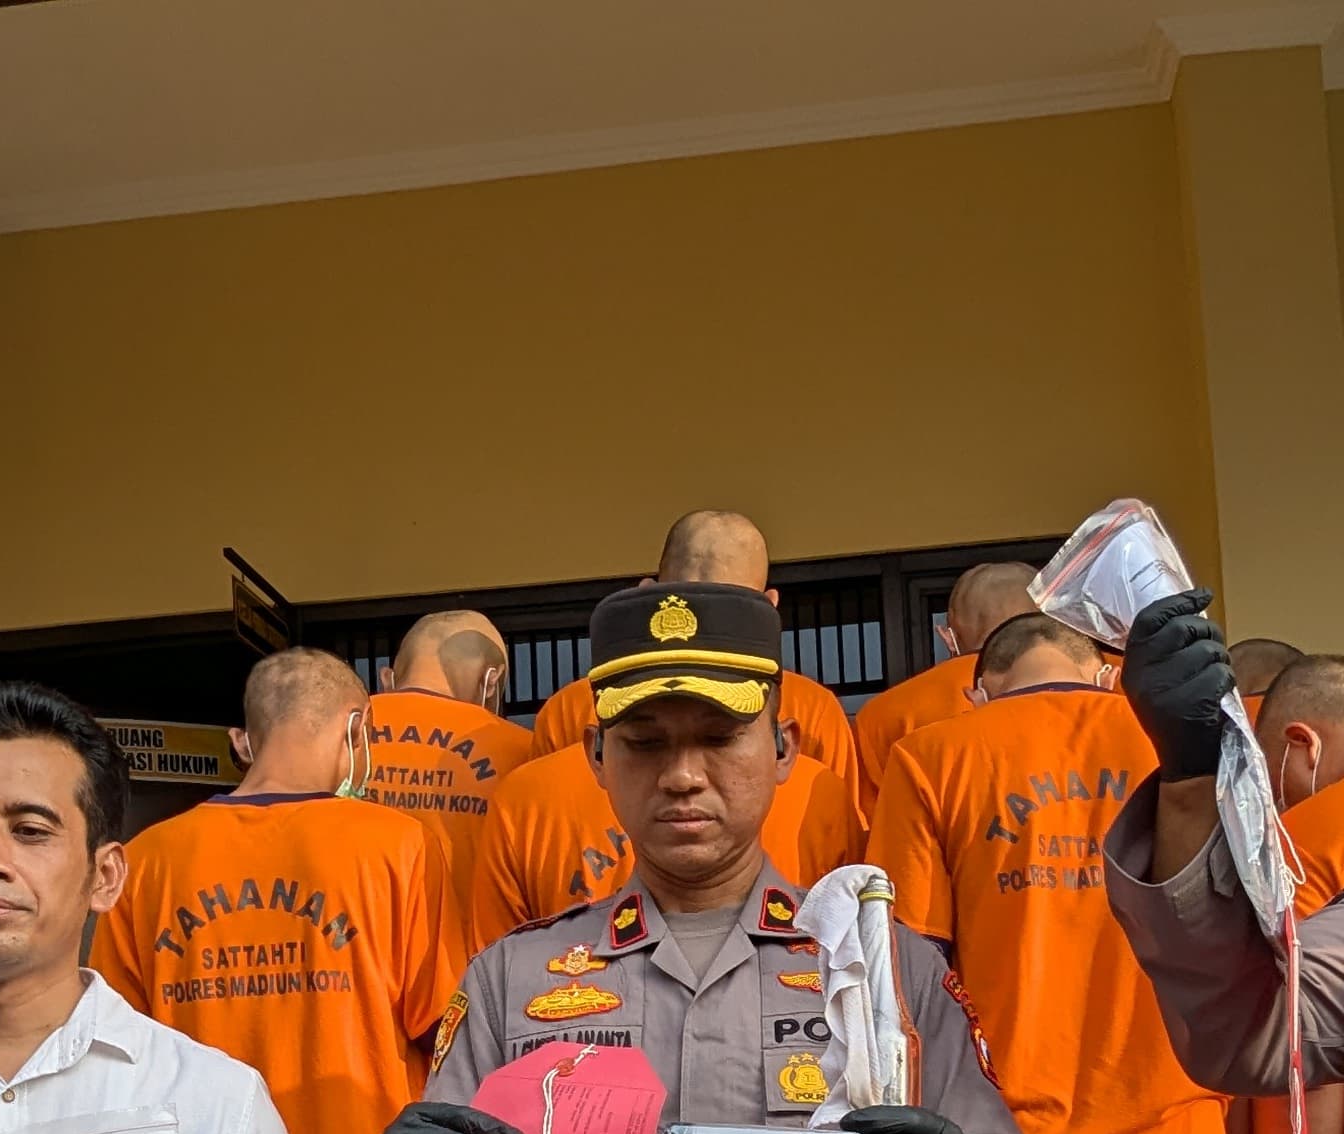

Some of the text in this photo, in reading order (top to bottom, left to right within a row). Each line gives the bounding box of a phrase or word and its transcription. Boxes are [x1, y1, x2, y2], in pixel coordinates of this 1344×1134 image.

[157, 754, 218, 775] HUKUM
[370, 725, 497, 781] HANAN
[374, 765, 453, 787] ATTAHTI
[384, 790, 446, 811] MADIUN
[449, 794, 489, 816] KOTA
[986, 768, 1129, 844] TAHAN
[1038, 834, 1101, 858] SATTA
[154, 878, 359, 958] TAHANAN
[201, 942, 306, 970] SATTAHTI
[162, 970, 352, 1005] POLRES MADIUN KOTA
